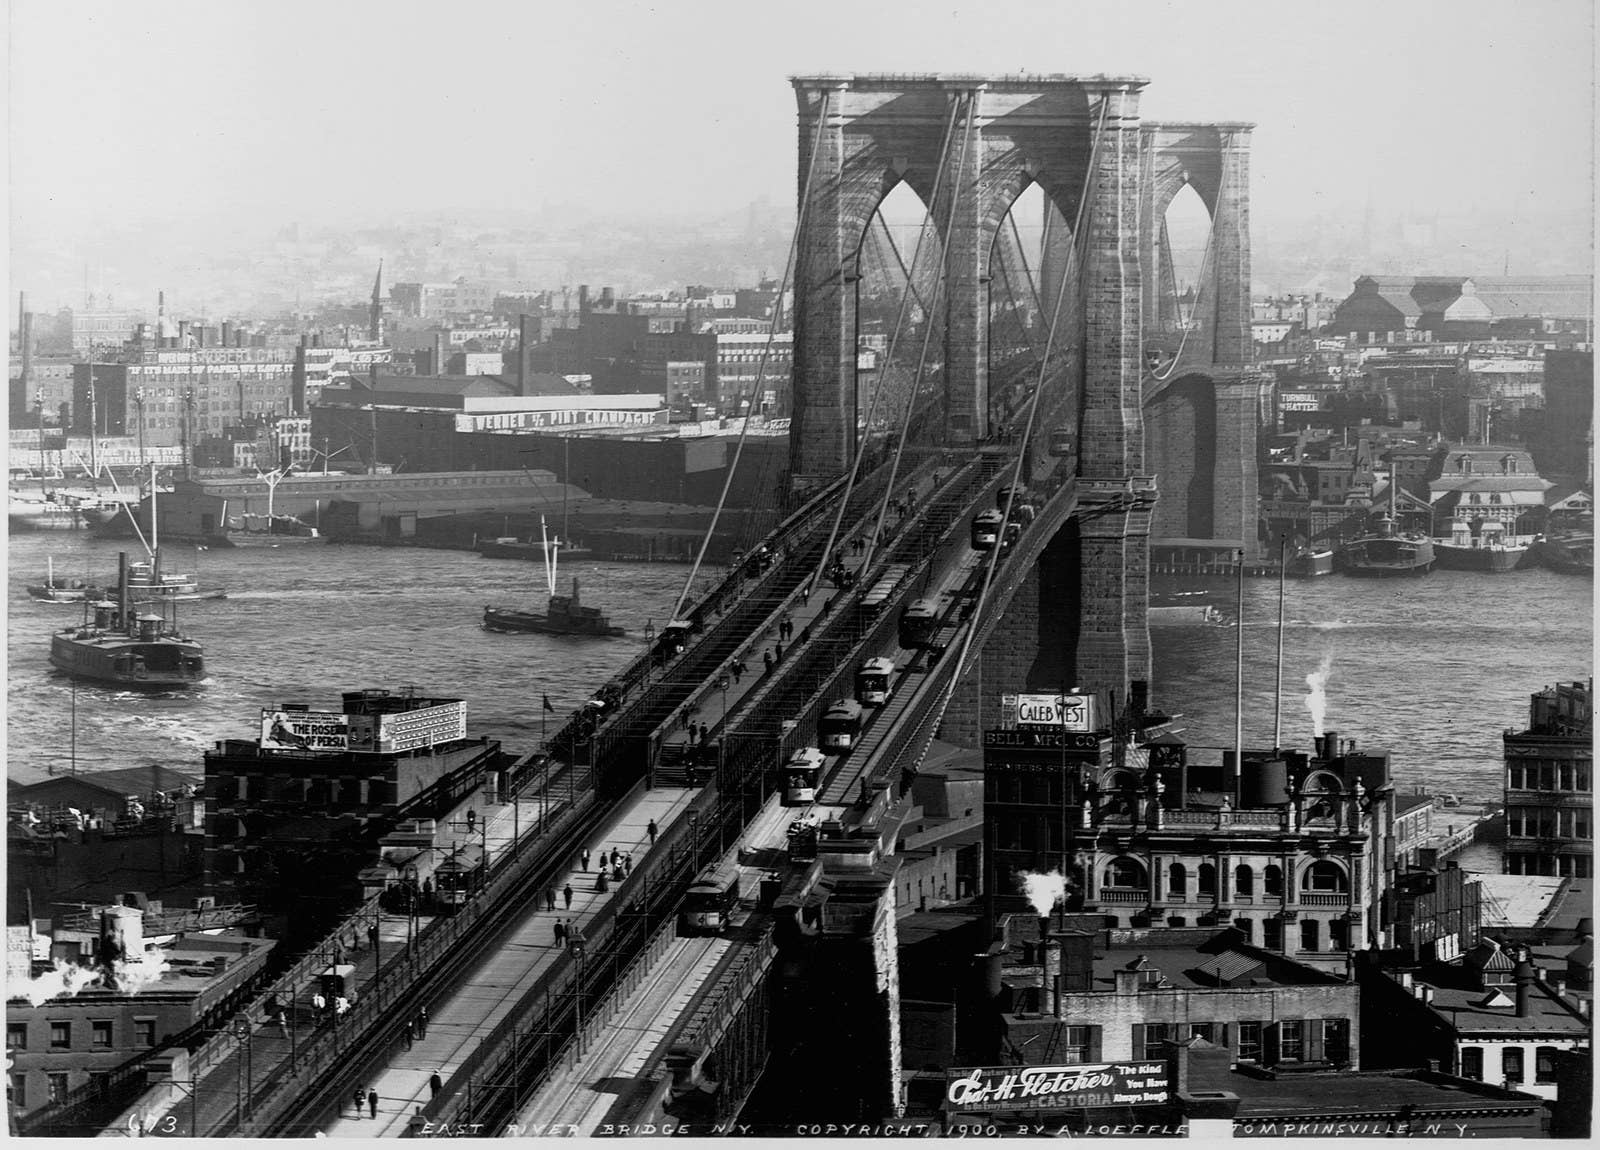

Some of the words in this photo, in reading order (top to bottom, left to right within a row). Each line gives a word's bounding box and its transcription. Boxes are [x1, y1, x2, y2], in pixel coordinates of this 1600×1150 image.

[550, 411, 578, 425] PINT
[1019, 703, 1054, 722] CALEB
[1054, 702, 1087, 723] WEST
[292, 724, 311, 735] THE
[311, 725, 337, 736] ROSE
[305, 736, 317, 746] OF
[317, 737, 347, 747] PERSIA
[985, 733, 1025, 745] BELL
[1075, 735, 1099, 748] CO.
[1139, 1064, 1162, 1075] Kind
[1020, 1064, 1114, 1098] Fletcher
[1126, 1079, 1144, 1089] You
[1147, 1078, 1168, 1088] Have
[1038, 1093, 1112, 1108] CASTORIA
[1113, 1093, 1143, 1104] Always
